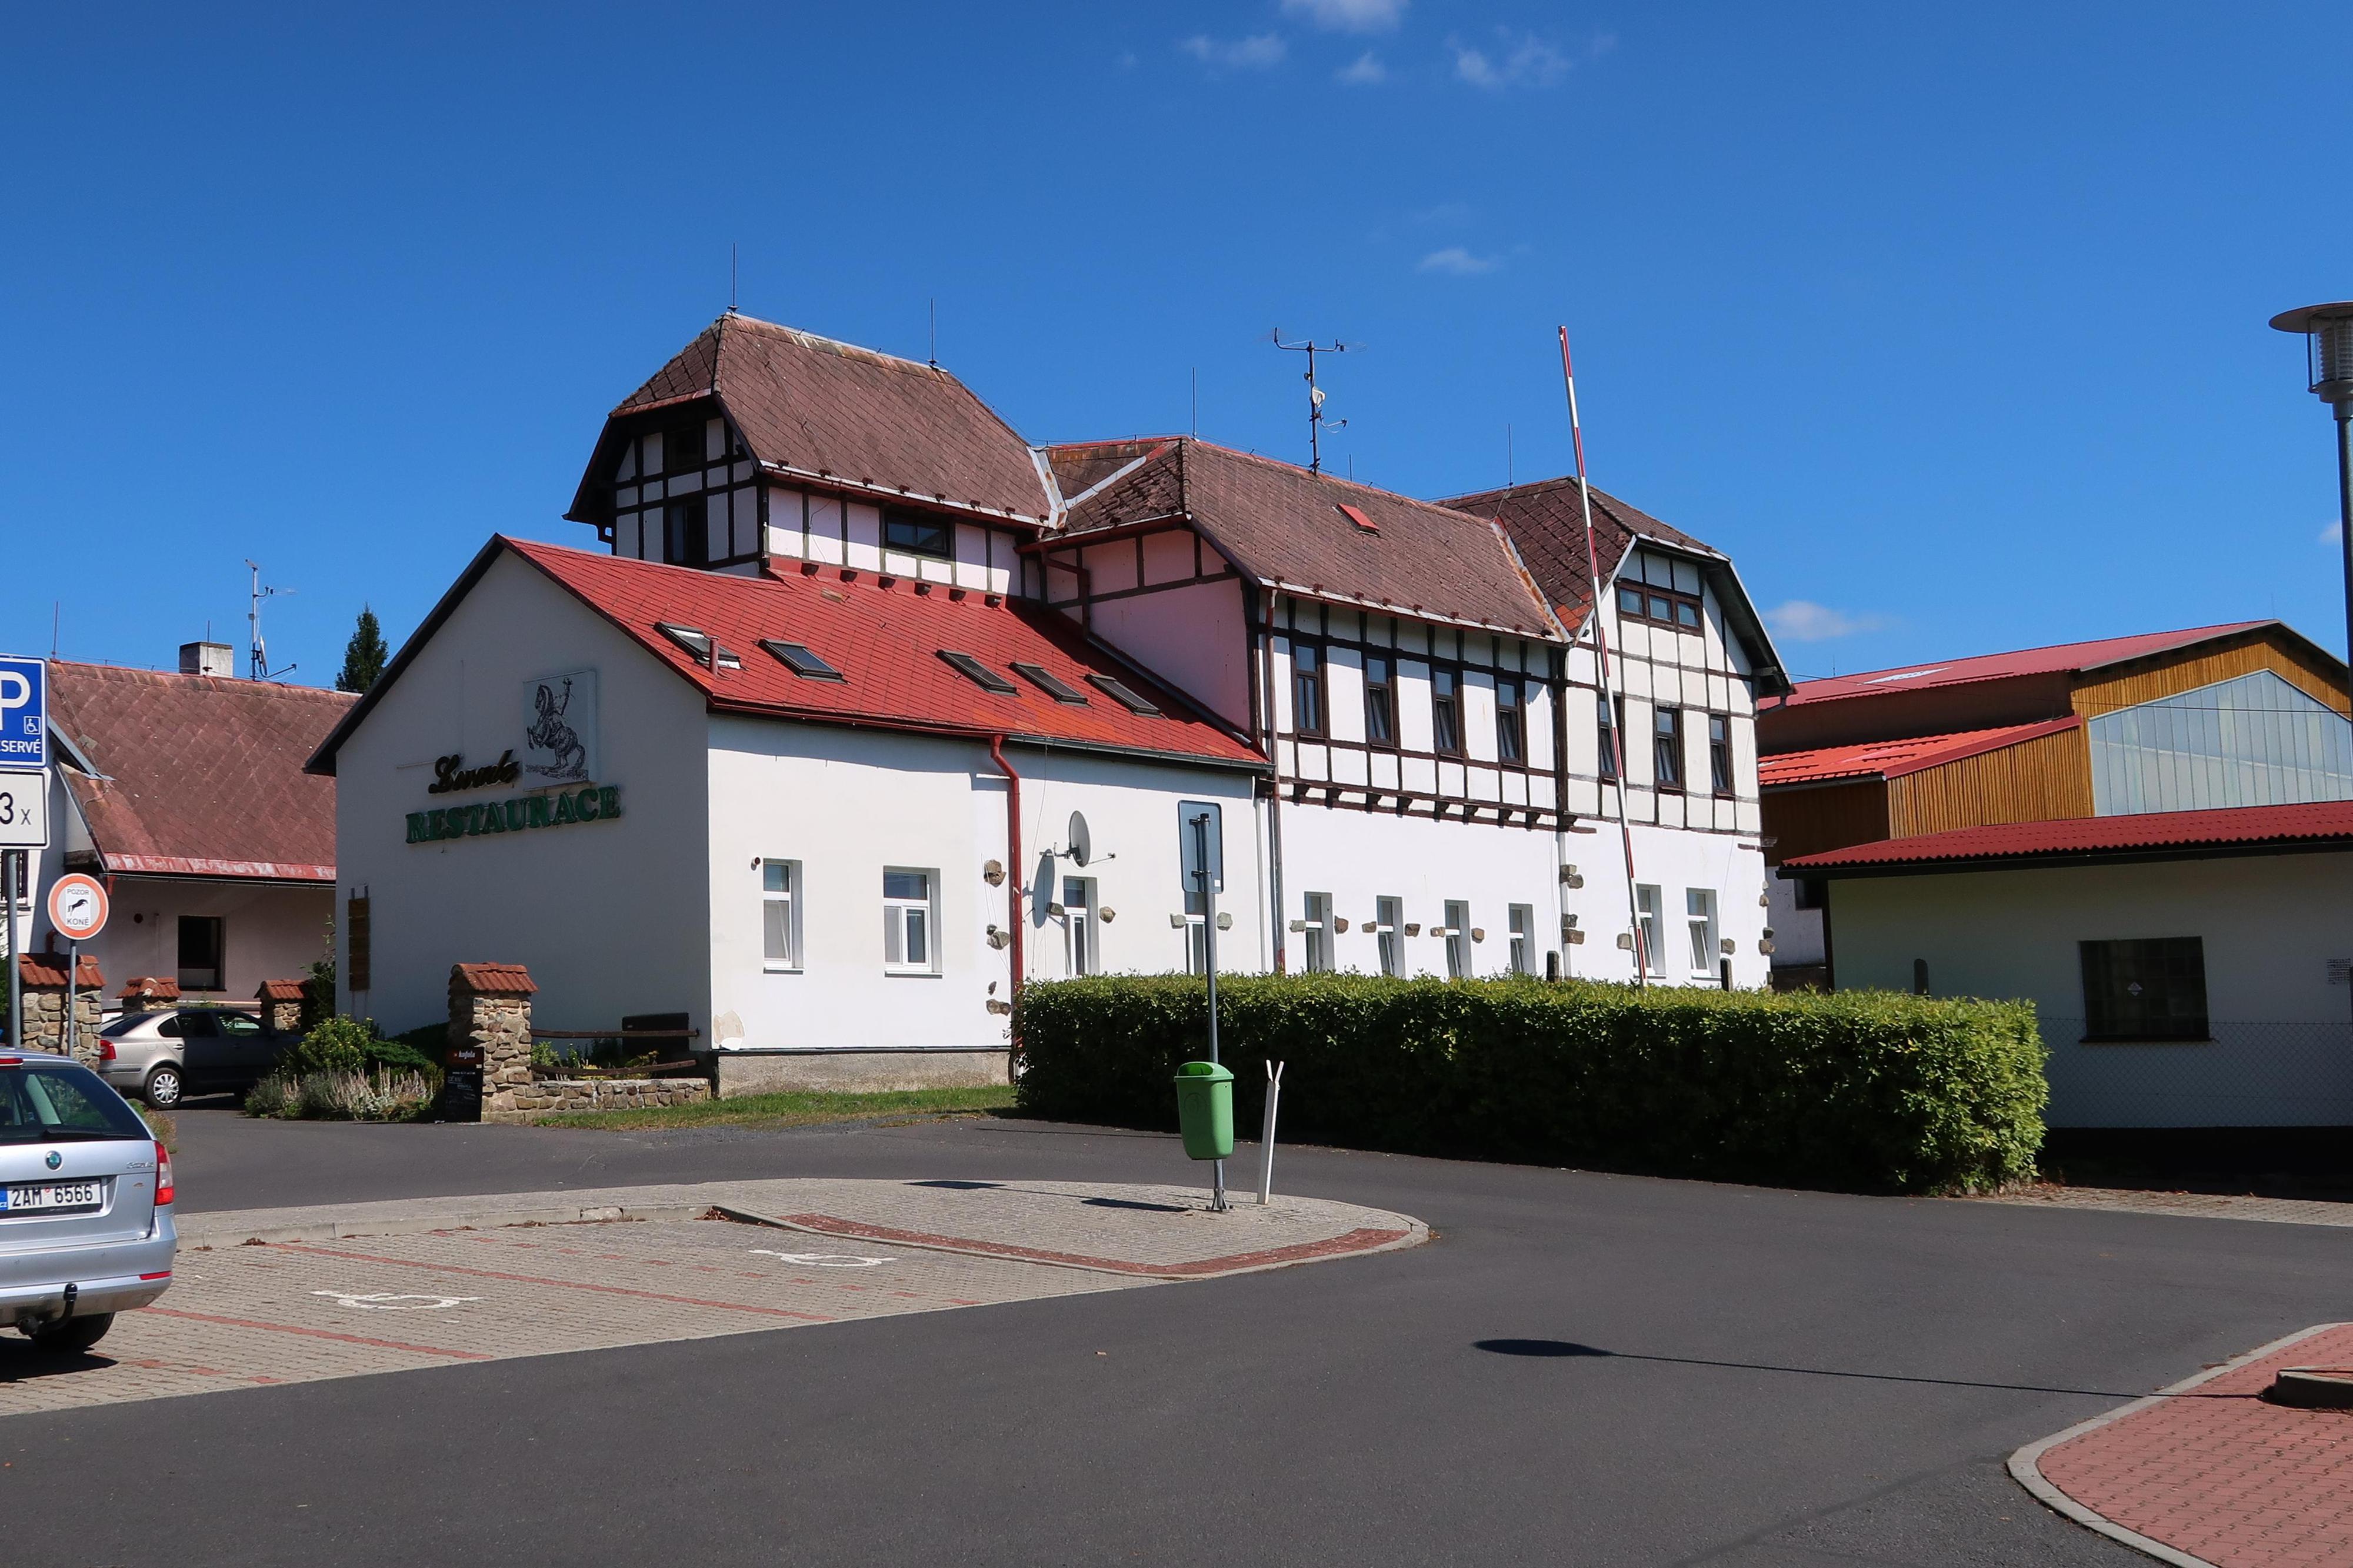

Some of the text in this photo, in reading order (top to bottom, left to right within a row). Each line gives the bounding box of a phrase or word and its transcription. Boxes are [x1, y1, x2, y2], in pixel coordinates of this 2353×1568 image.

[0, 671, 31, 730] P
[0, 739, 41, 753] SERVÉ
[406, 786, 621, 844] RESTAURACE
[12, 1187, 42, 1206] 2AM
[55, 1184, 92, 1203] 6566
